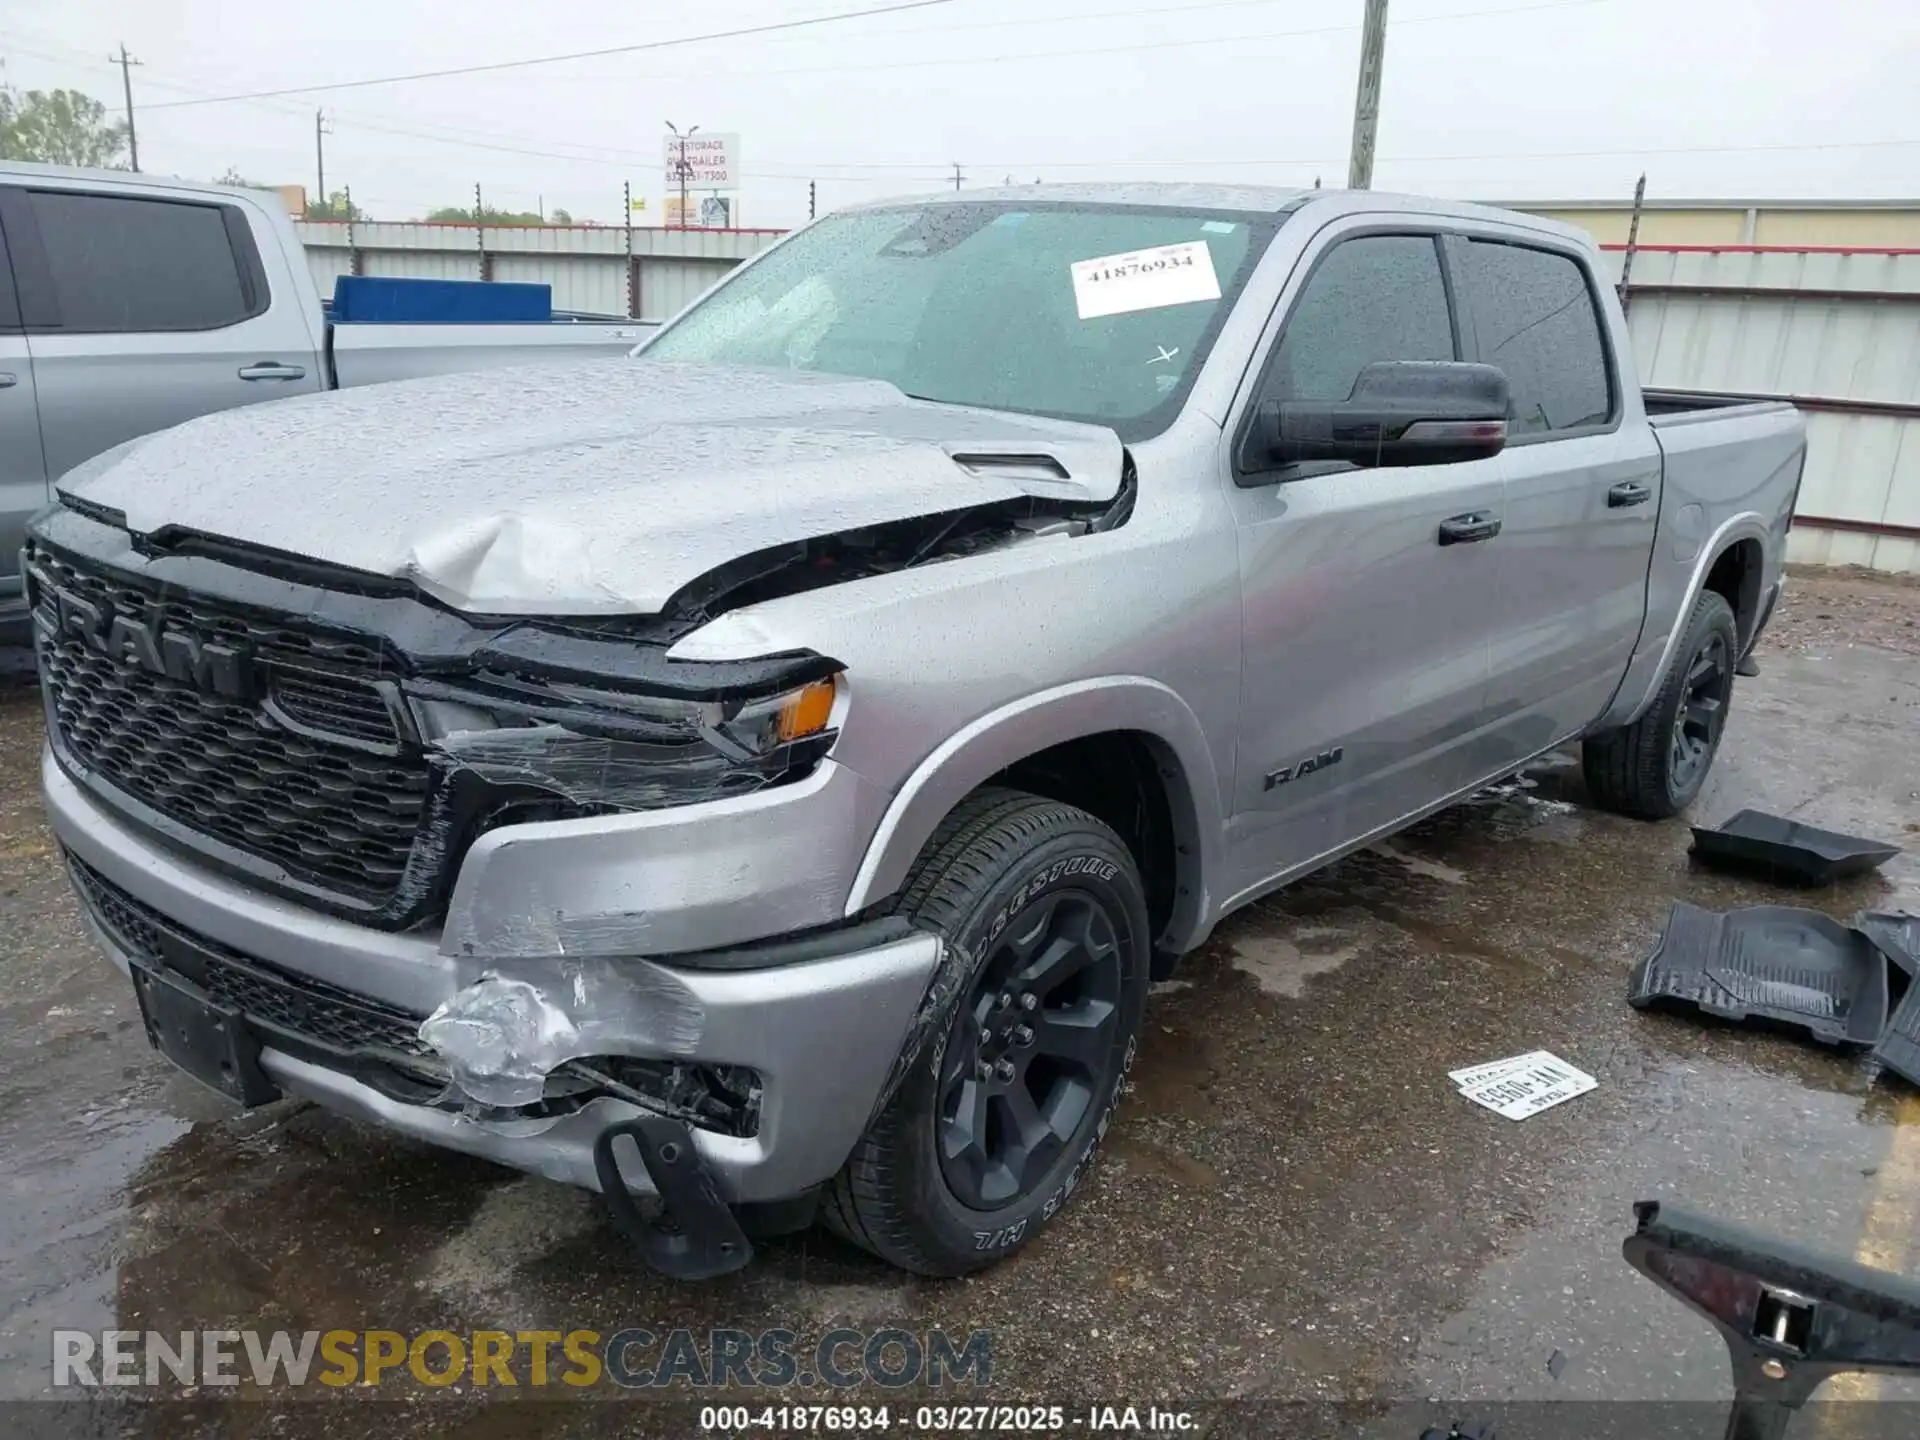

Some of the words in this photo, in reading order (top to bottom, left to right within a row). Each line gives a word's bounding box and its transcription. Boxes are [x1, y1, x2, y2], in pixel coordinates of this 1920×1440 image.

[685, 140, 724, 152] STORAGE
[687, 155, 726, 166] TRAILER
[666, 170, 728, 182] 832251-7300
[1088, 255, 1193, 282] 41876934
[54, 585, 254, 699] RAM
[1263, 746, 1344, 792] RAM
[1529, 1088, 1569, 1107] TEXAS
